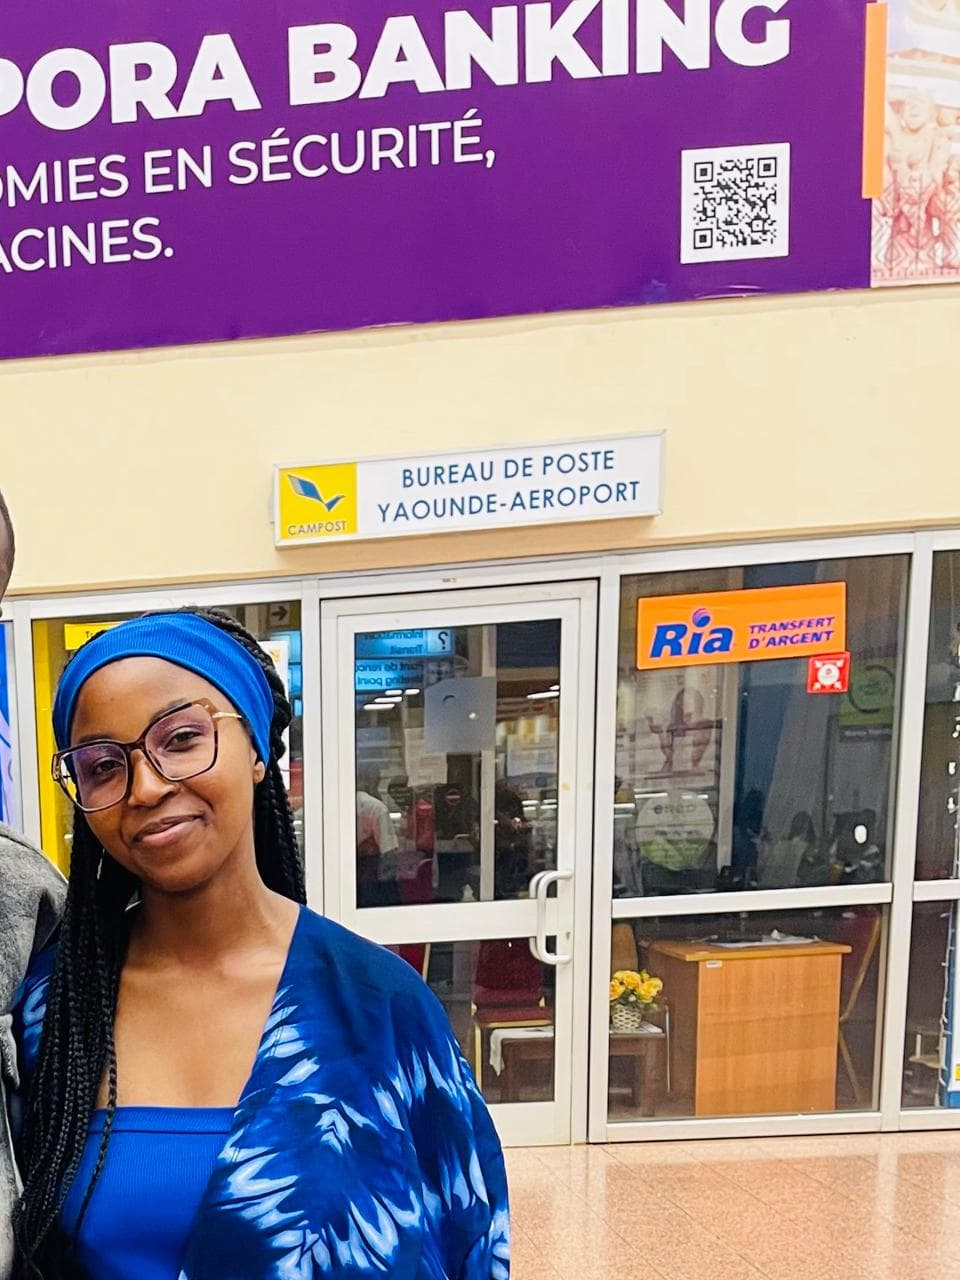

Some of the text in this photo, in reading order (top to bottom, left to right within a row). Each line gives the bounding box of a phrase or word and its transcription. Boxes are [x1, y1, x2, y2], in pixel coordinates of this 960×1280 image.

[287, 0, 792, 106] BANKING
[144, 145, 212, 194] EN
[228, 108, 496, 185] SÉCURITÉ,
[402, 450, 614, 489] BUREAU DE POSTE
[377, 480, 640, 523] YAOUNDE-AEROPORT
[287, 519, 347, 536] CAMPOST
[649, 608, 734, 659] Ria
[747, 630, 835, 650] D'ARGENT
[748, 616, 836, 635] TRANSFERT
